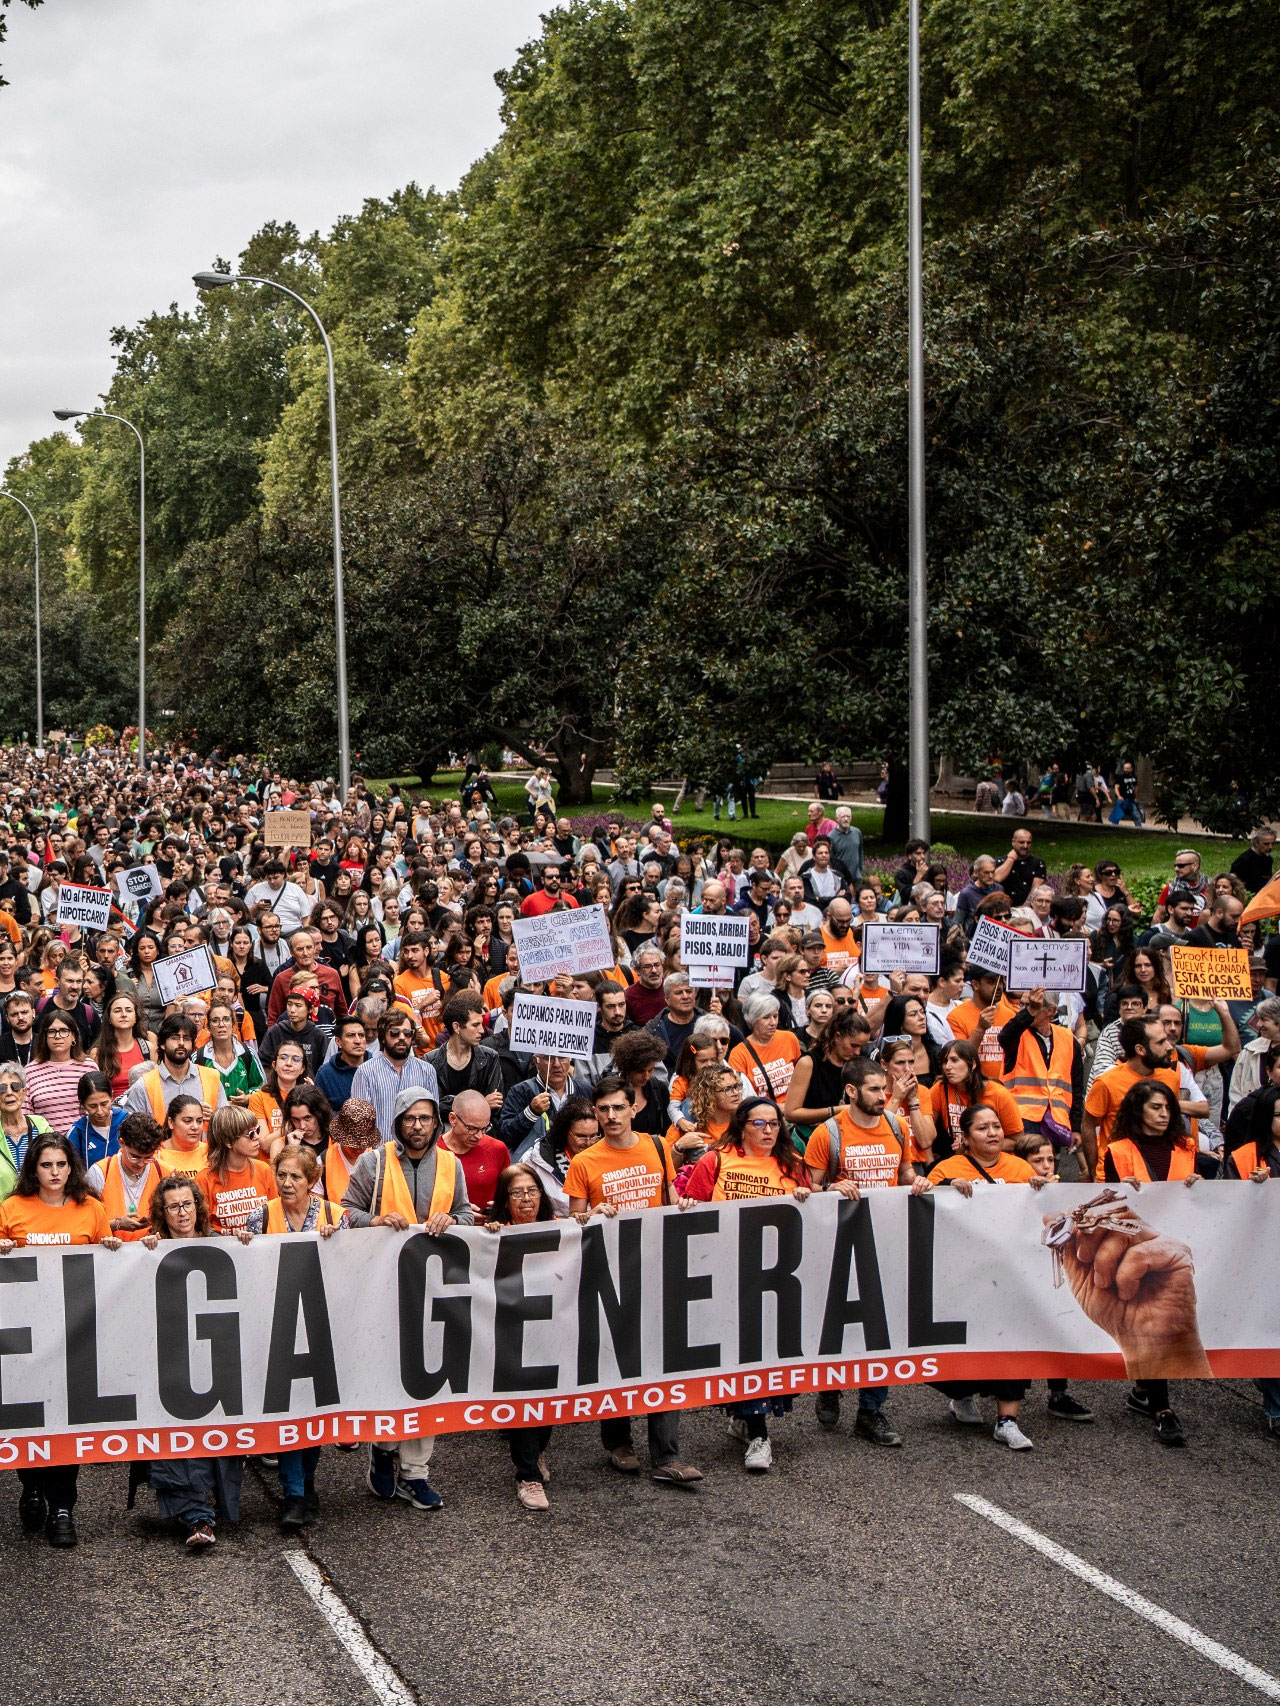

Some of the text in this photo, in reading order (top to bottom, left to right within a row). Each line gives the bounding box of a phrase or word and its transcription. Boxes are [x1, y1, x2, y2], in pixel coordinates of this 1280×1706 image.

[128, 874, 148, 885] STOP
[61, 888, 110, 907] NO al FRAUDE
[60, 906, 107, 925] HIPOTECARIO!
[531, 917, 548, 931] DE
[686, 921, 747, 938] SUELDOS, ARRIBA!
[882, 927, 924, 935] LA emvs
[978, 921, 1001, 940] PISOS:
[569, 923, 603, 941] ANTES
[555, 945, 573, 958] QUE
[685, 940, 746, 958] PISOS, ABAJO!
[1026, 943, 1070, 951] LA emvs
[969, 951, 977, 960] Es
[976, 955, 983, 963] ya
[1174, 961, 1206, 973] VUELVE
[1208, 963, 1214, 973] A
[1175, 971, 1241, 985] ESTAS CASAS
[1179, 983, 1252, 998] SON NUESTRAS
[517, 1003, 593, 1029] OCUPAMOS PARA VIVIR.
[514, 1026, 557, 1047] ELLOS, PARA
[845, 1144, 885, 1157] SINDICATO
[847, 1156, 899, 1168] DE INQUILINAS
[602, 1165, 647, 1183] SINDICATO
[726, 1172, 769, 1185] SINDICATO
[848, 1168, 895, 1181] E INQUILINOS
[605, 1174, 660, 1194] DE INQUILINAS
[726, 1181, 784, 1196] DE INQUILINAS
[216, 1186, 257, 1203] SINDICATO
[612, 1188, 656, 1203] INQUILINOS
[218, 1204, 229, 1216] DE
[618, 1200, 649, 1212] MADRID
[26, 1232, 70, 1245] SINDICATO
[397, 1192, 968, 1401] GENERAL
[75, 1427, 256, 1458] FONDOS
[278, 1412, 420, 1446] BUITRE
[463, 1382, 687, 1425] CONTRATOS
[704, 1357, 939, 1400] INDEFINIDOS
